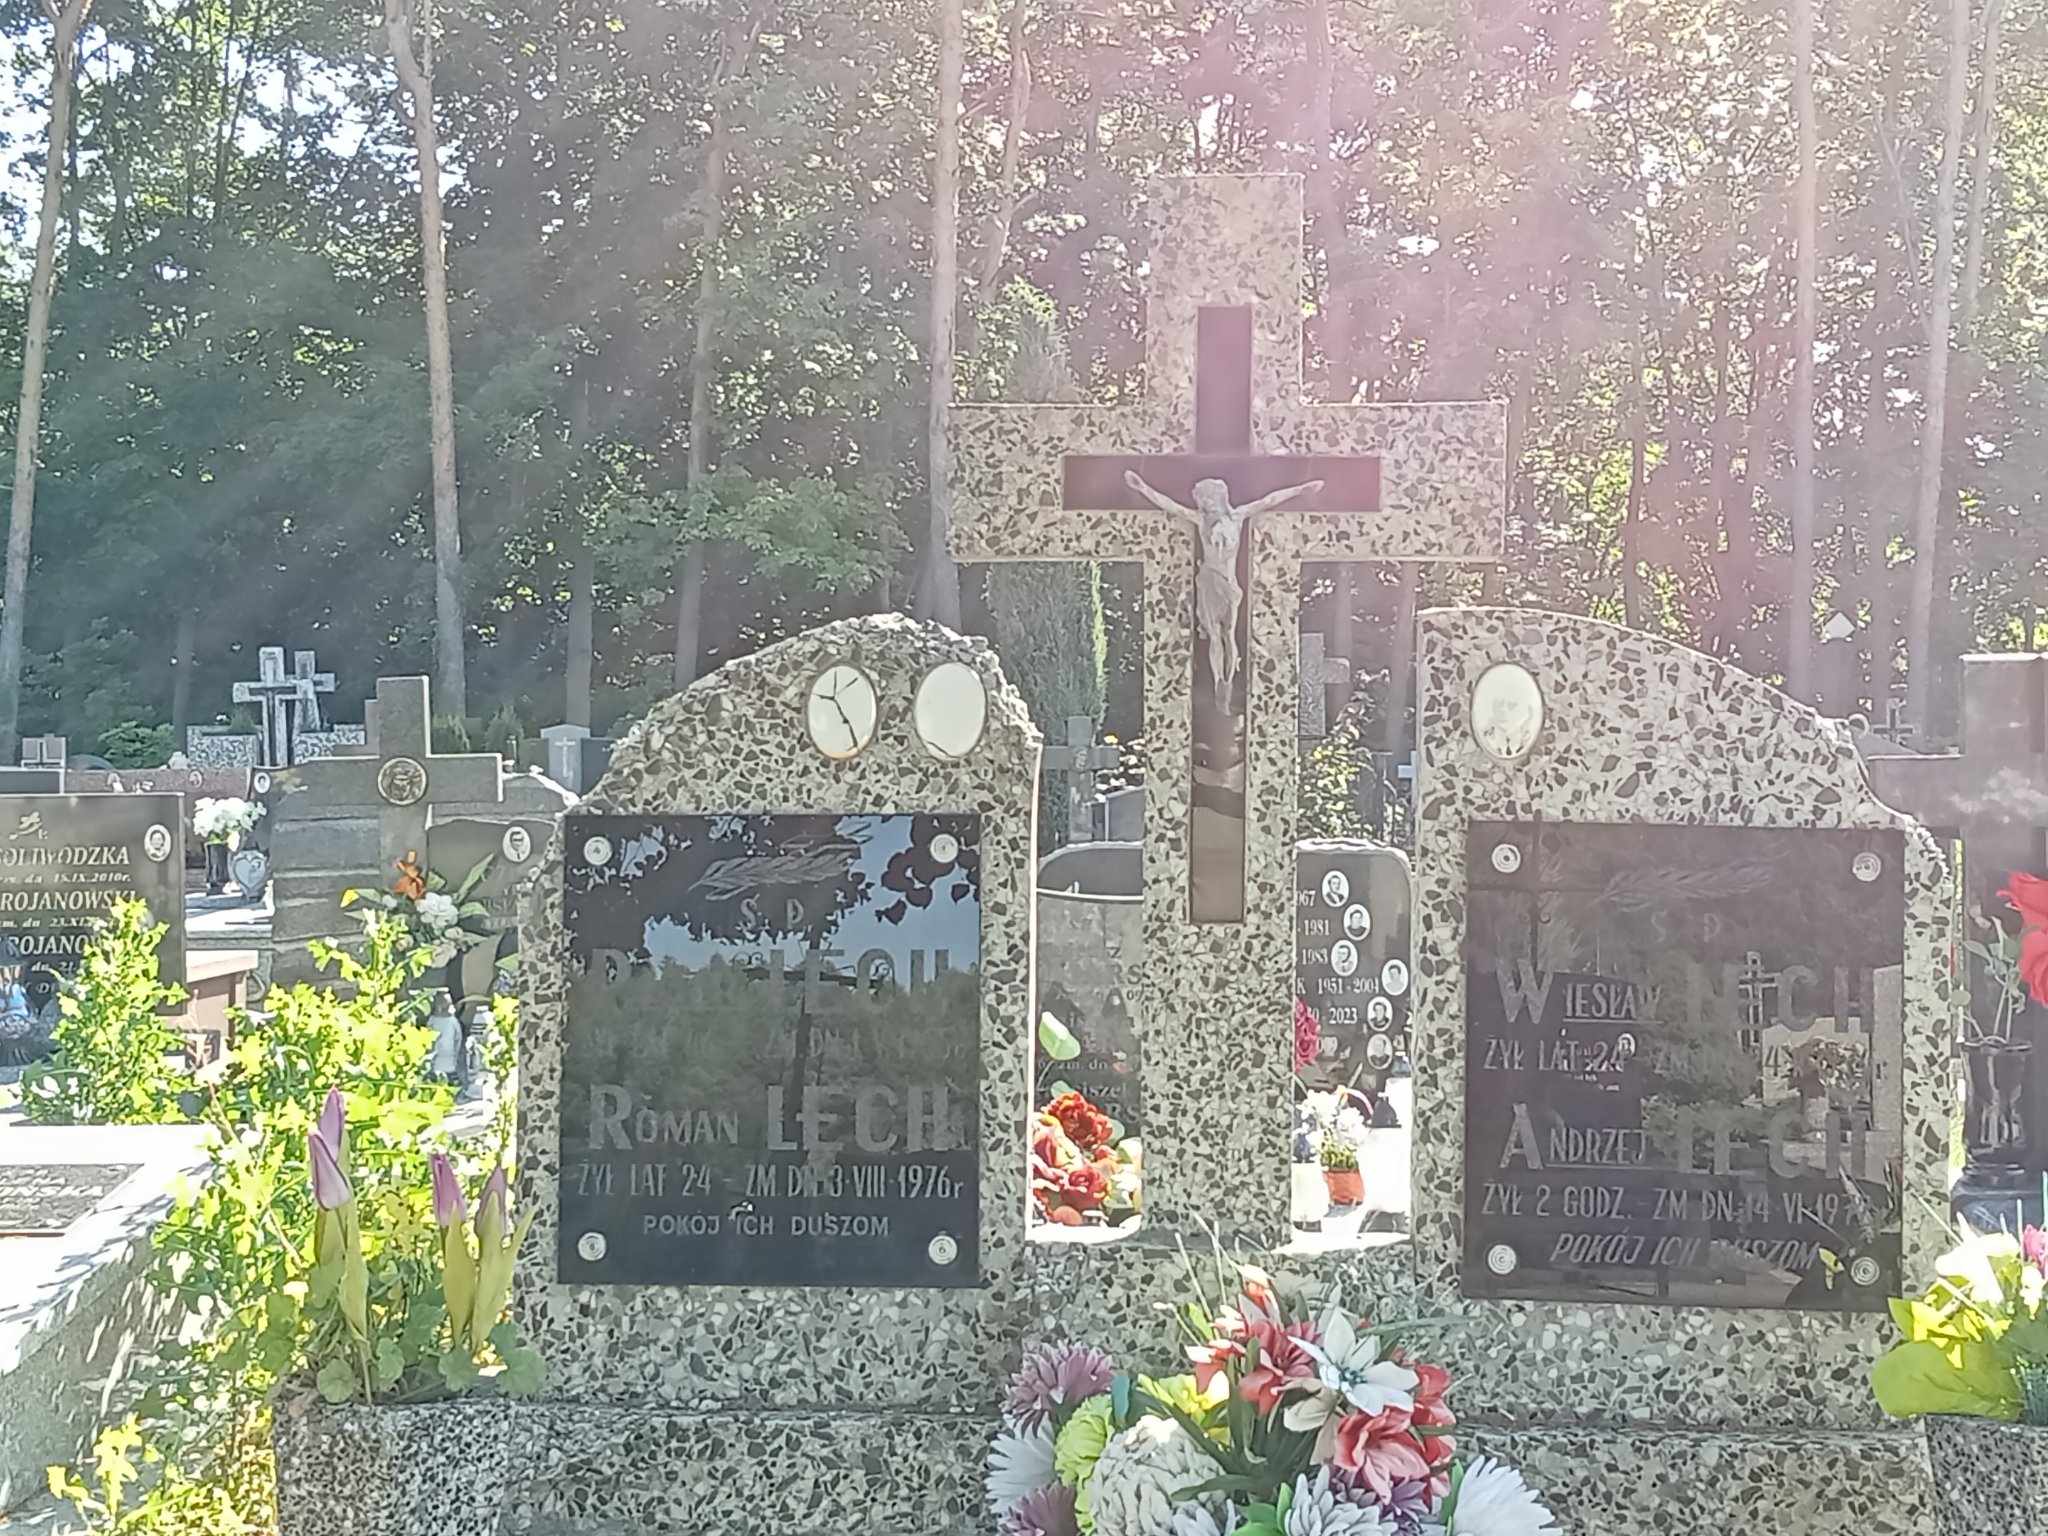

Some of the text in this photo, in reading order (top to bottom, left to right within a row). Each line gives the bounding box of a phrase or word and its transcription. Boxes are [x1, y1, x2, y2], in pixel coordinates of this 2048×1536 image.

[0, 846, 130, 866] OLIWODZKA
[0, 890, 137, 911] ROJANOWSKI
[1304, 919, 1331, 935] 1981
[1329, 1007, 1358, 1024] 2023
[1539, 1040, 1579, 1071] LAT
[766, 1084, 952, 1153] LECH
[1498, 1102, 1867, 1179] ANDRZEJ LECH
[630, 1163, 666, 1197] LAT
[681, 1163, 711, 1197] 24
[1481, 1179, 1523, 1217] ŻYŁ
[1535, 1185, 1552, 1218] 2
[643, 1210, 720, 1236] POKÓJ
[736, 1214, 774, 1236] ICH
[1550, 1225, 1645, 1265] POKÓJ
[1650, 1236, 1702, 1266] ICH
